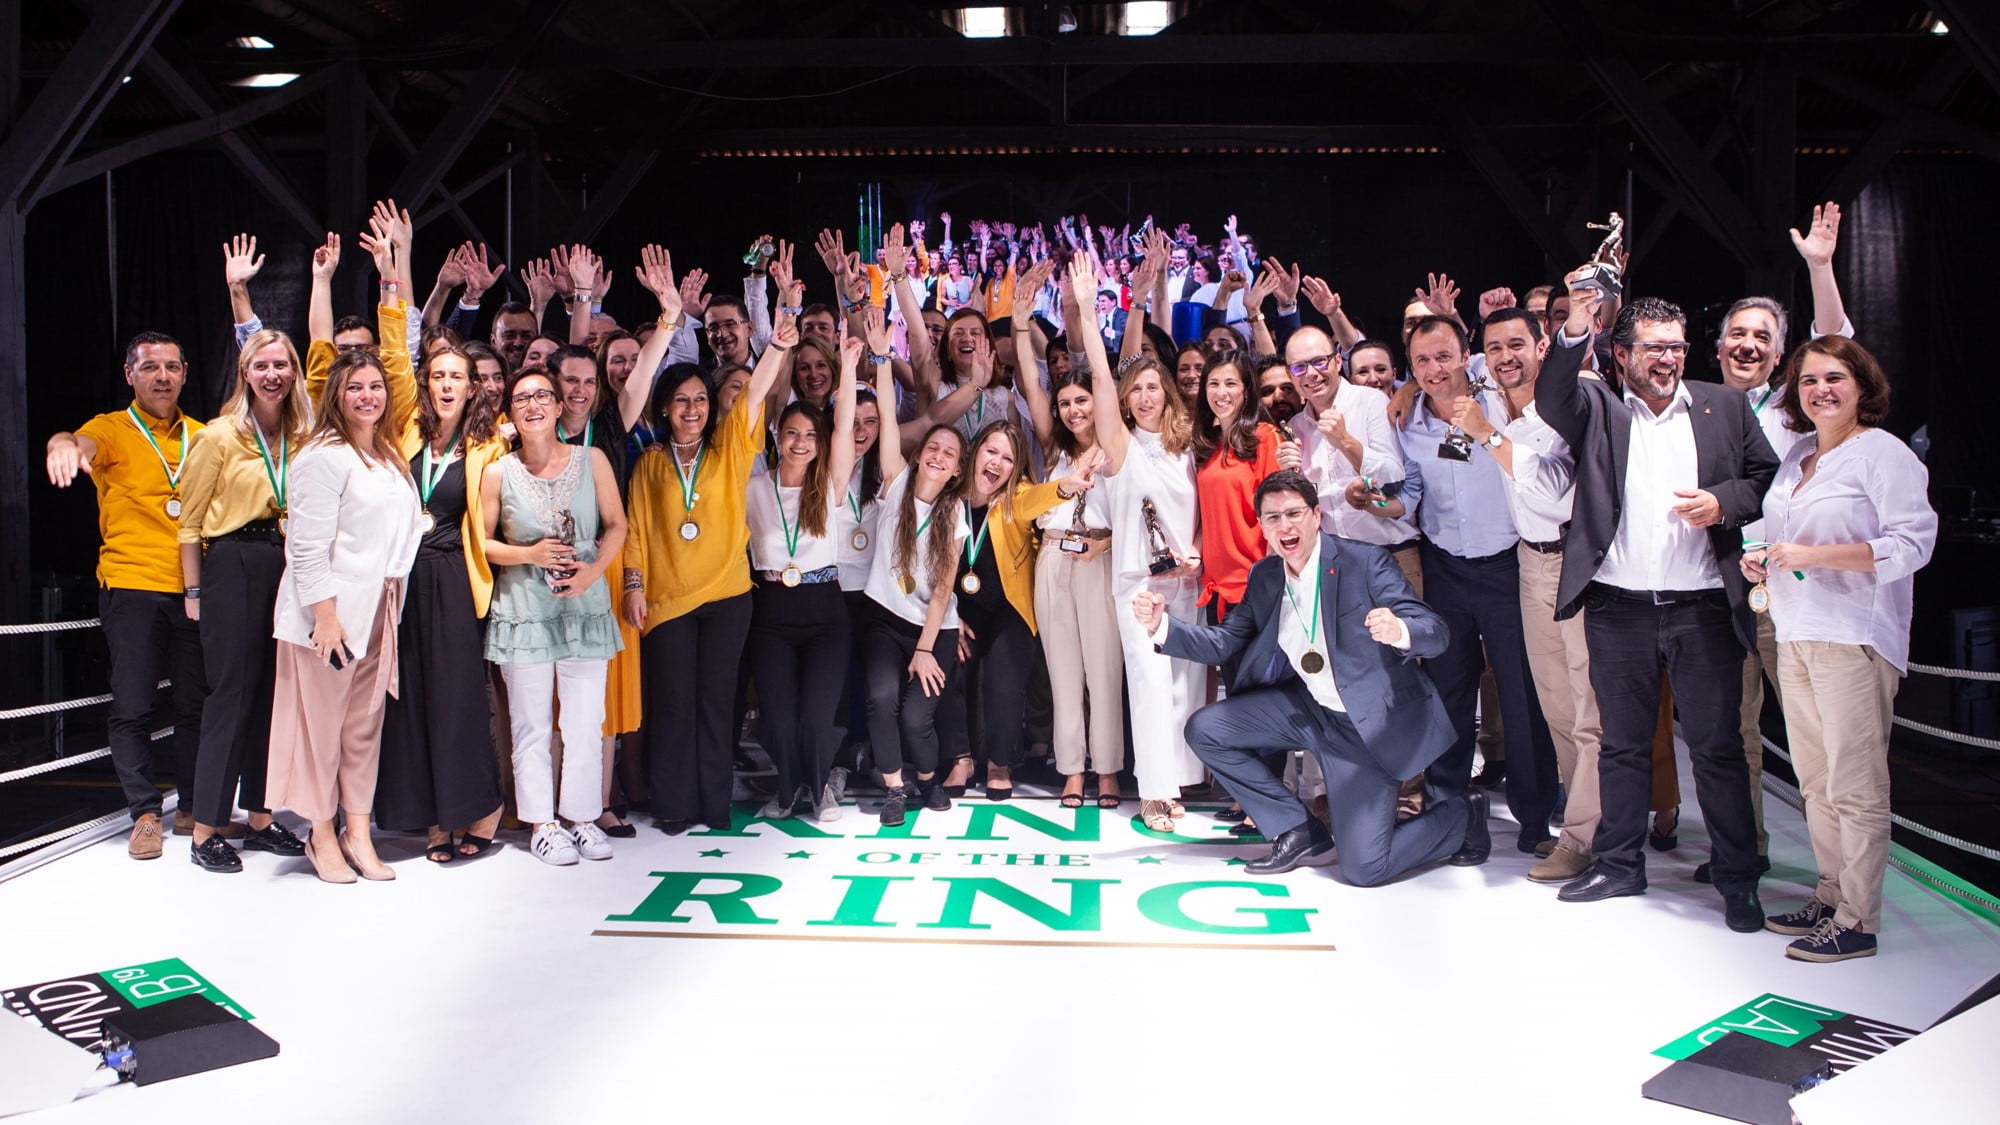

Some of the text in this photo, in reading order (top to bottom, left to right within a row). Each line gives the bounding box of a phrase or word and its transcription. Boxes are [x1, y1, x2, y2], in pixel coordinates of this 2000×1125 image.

[856, 852, 1091, 867] OF THE
[604, 871, 1319, 935] RING
[1697, 998, 1833, 1046] LA
